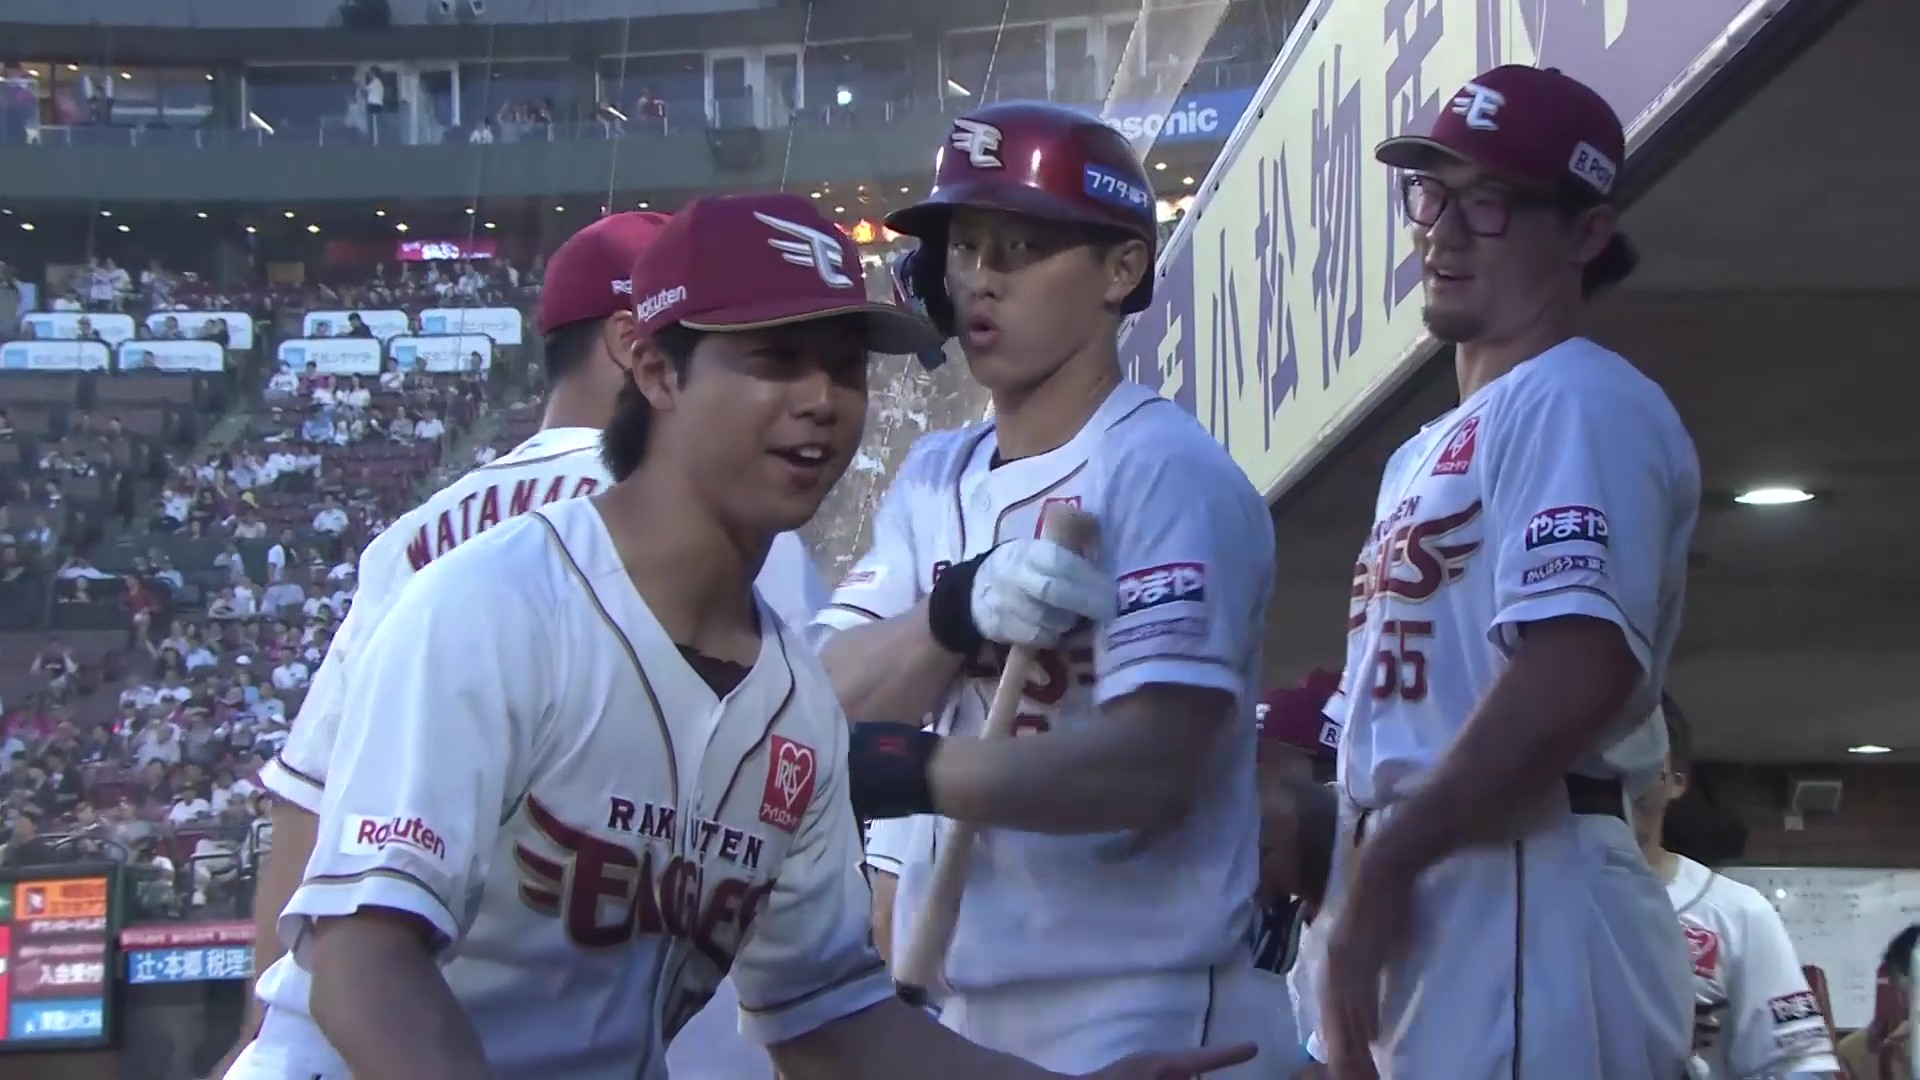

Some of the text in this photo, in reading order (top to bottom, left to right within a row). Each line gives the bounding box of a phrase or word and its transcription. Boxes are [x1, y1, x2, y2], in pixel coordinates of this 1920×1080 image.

[1530, 509, 1608, 544] やまや
[1119, 567, 1202, 610] やまや
[774, 758, 802, 794] IRIS
[357, 816, 446, 861] Rauten
[608, 796, 765, 870] RAKUTEN
[514, 792, 778, 975] EAGE
